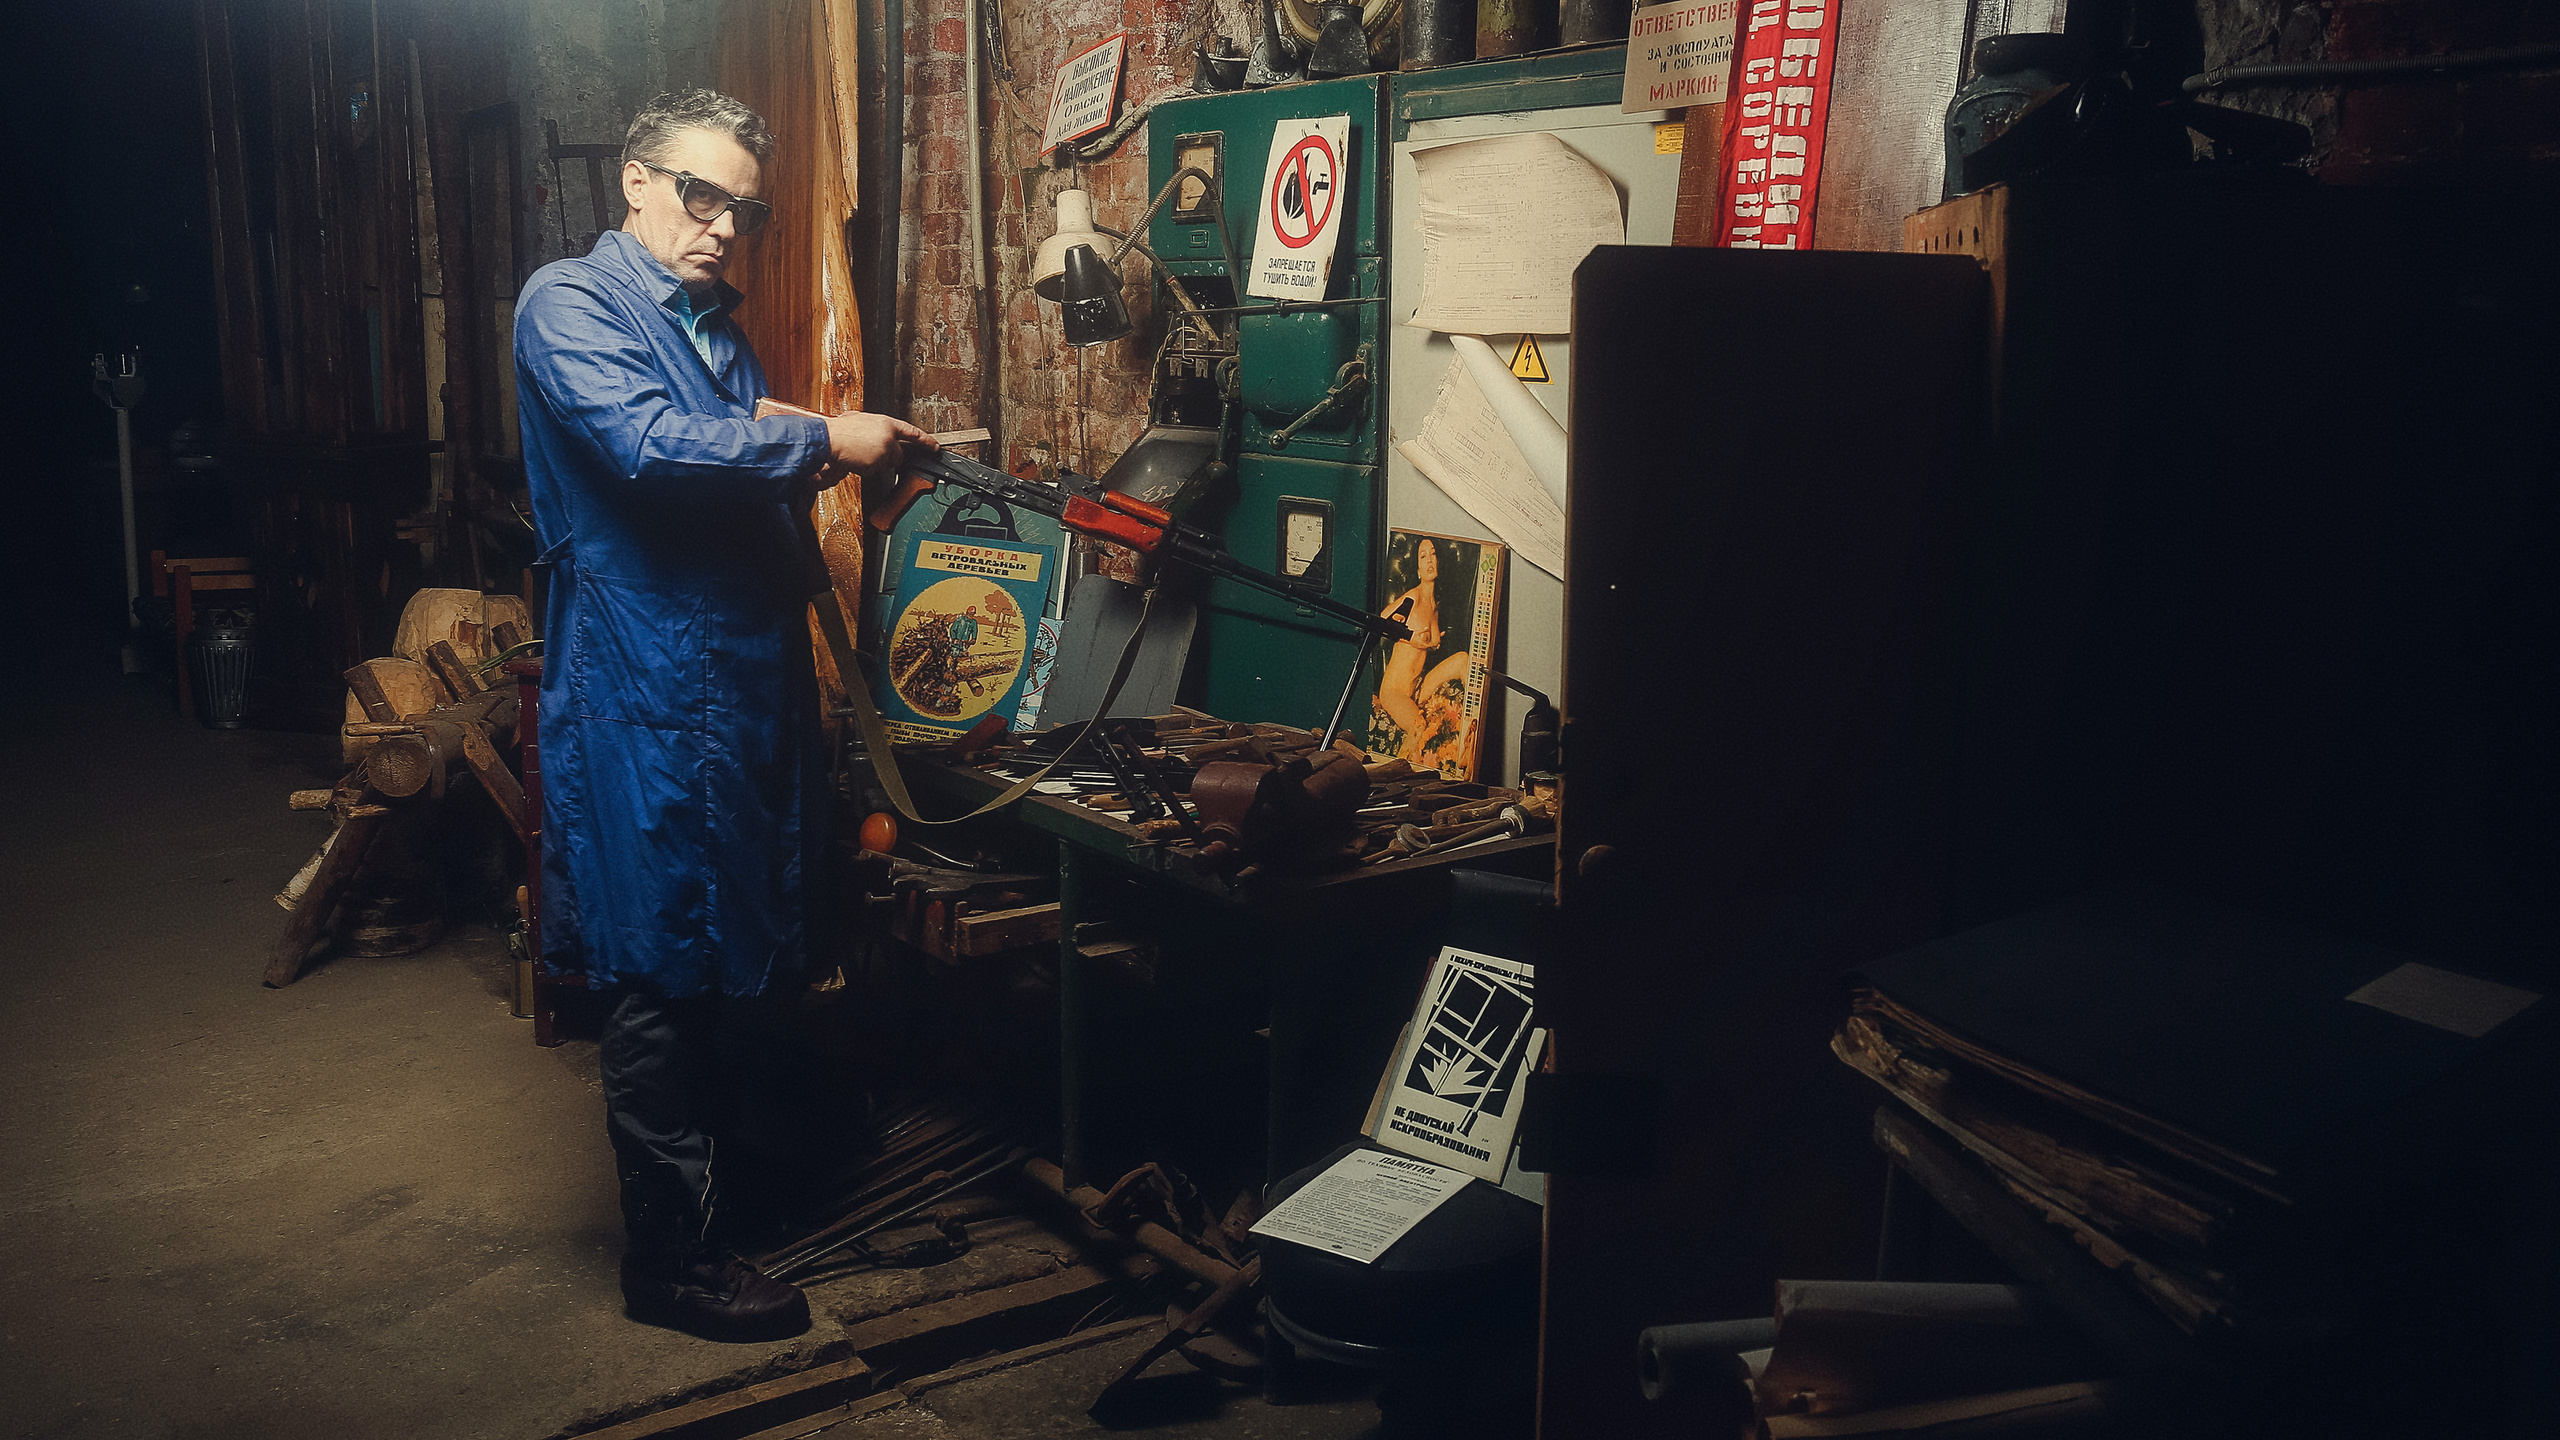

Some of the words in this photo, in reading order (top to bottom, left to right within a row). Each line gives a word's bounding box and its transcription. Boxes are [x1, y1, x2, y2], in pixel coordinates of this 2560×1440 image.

[1647, 47, 1662, 61] ЗА
[1666, 34, 1734, 58] ЭКСПЛУАТА
[1659, 60, 1667, 73] И
[1063, 65, 1116, 105] НАПРЯЖЕНИЕ
[1649, 74, 1718, 102] МАРКИН
[1064, 92, 1105, 118] ОПАСНО
[1054, 122, 1073, 140] ДЛЯ
[1073, 102, 1109, 129] ЖИЗНИ!
[1730, 57, 1775, 250] СОРЕВН
[1268, 257, 1316, 273] ЗАПРЕЩАЕТСЯ
[1263, 272, 1290, 286] ТУШИТЬ
[1290, 273, 1318, 288] ВОДОЙ!
[931, 552, 1028, 571] ВЕТРОВАЛЬНЫХ
[945, 545, 1019, 561] УБОРКА
[947, 562, 1009, 576] ДЕРЕВЬЕВ
[1393, 1105, 1406, 1118] НЕ
[1405, 1109, 1455, 1135] ДОПУСКАЙ
[1389, 1118, 1491, 1163] ИСКРООБРАЗОВАНИЯ
